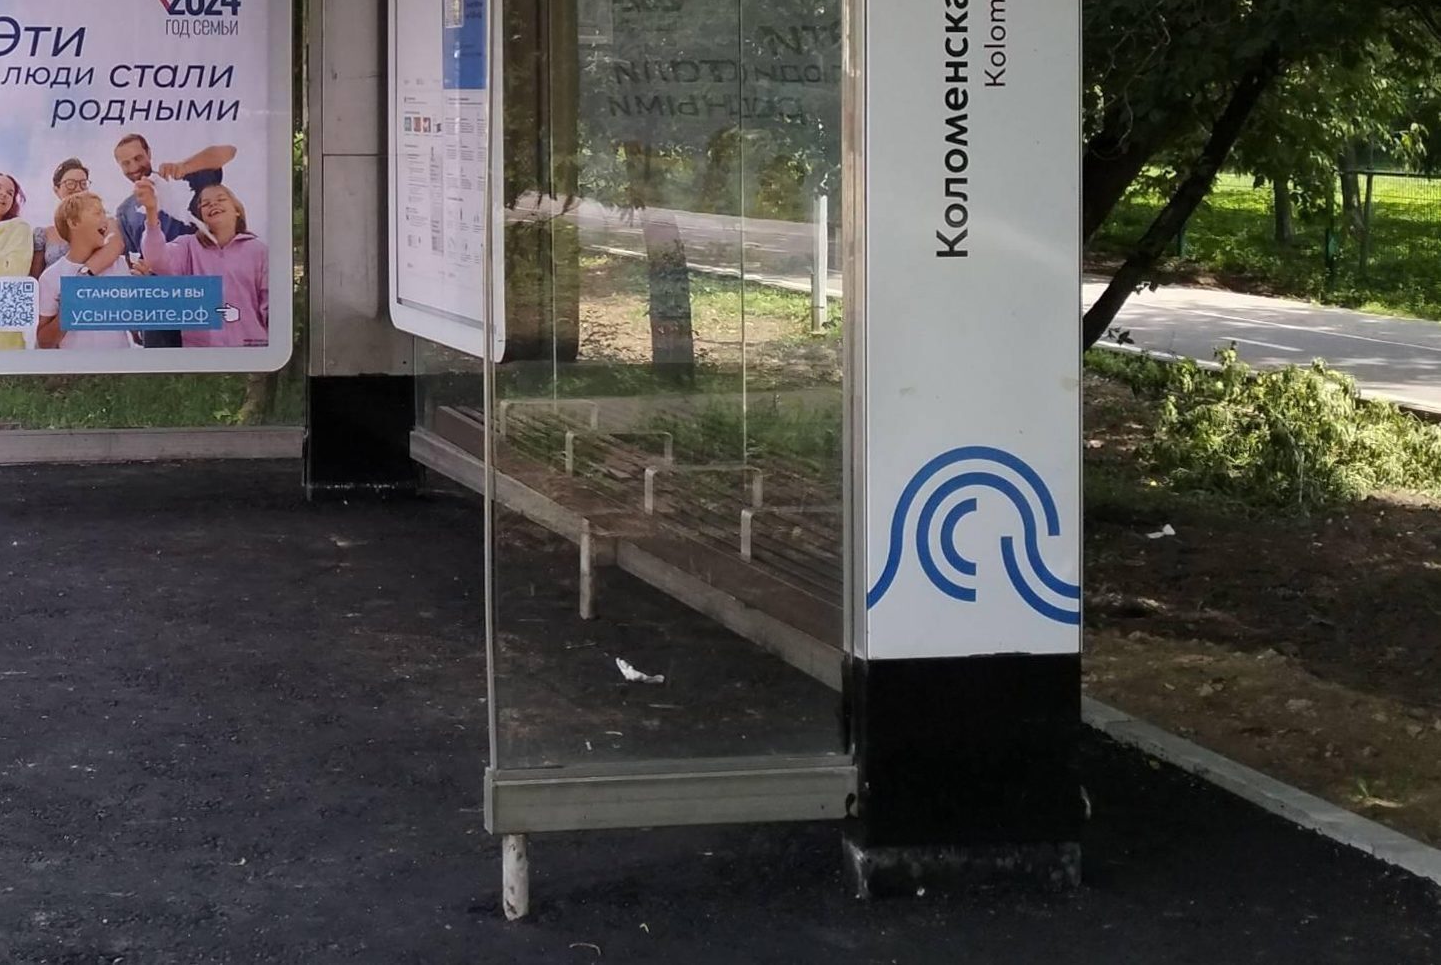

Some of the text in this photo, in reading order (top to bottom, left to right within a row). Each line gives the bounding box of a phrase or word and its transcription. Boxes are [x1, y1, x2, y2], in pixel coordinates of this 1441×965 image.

[165, 19, 191, 38] ГОД
[1, 64, 235, 89] люди стали
[51, 98, 241, 128] родными
[76, 288, 204, 299] СТАНОВИТЕСЬ И ВЫ
[71, 305, 209, 324] усыновите.рф
